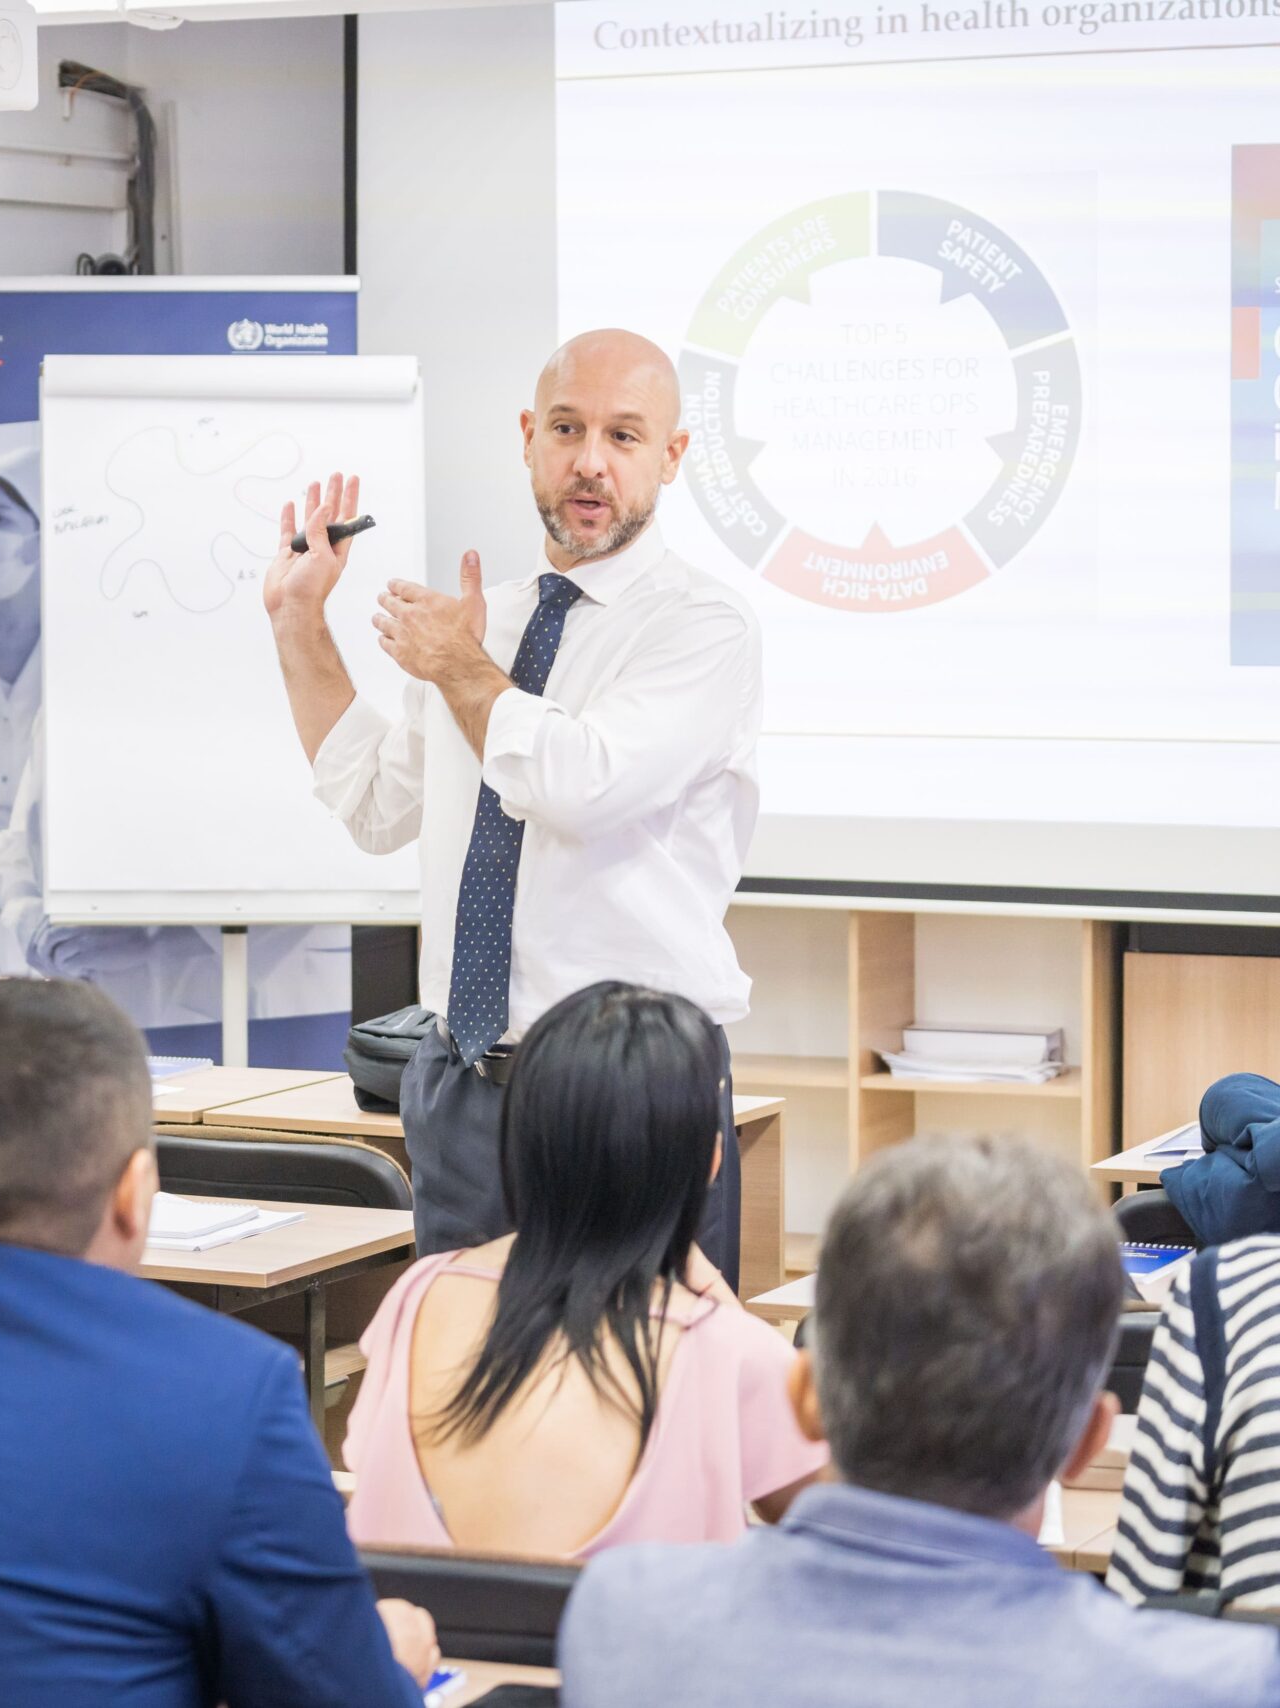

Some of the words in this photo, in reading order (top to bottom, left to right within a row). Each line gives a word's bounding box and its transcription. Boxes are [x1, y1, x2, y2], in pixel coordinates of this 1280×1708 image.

[593, 9, 865, 50] Contextualizing
[874, 5, 909, 35] in
[920, 0, 1030, 32] health
[717, 236, 791, 313] PATIENTS
[791, 214, 830, 245] ARE
[937, 240, 1007, 295] SAFETY
[947, 219, 1024, 282] PATIENT
[733, 233, 838, 322] CONSUMERS
[840, 322, 889, 345] TOP
[895, 322, 909, 345] 5
[769, 357, 925, 384] CHALLENGES
[932, 356, 981, 380] FOR
[684, 394, 703, 426] ON
[703, 370, 740, 489] REDUCTION
[772, 392, 922, 420] HEALTHCARE
[929, 391, 979, 415] OPS
[791, 427, 959, 453] MANAGEMENT
[987, 370, 1051, 527] PREPAREDNESS
[1014, 403, 1069, 527] EMERGENCY
[689, 429, 739, 528] EMPHASIS
[728, 491, 768, 537] COST
[801, 550, 950, 582] ENVIRONMENT
[821, 575, 929, 602] DATA-RICH
